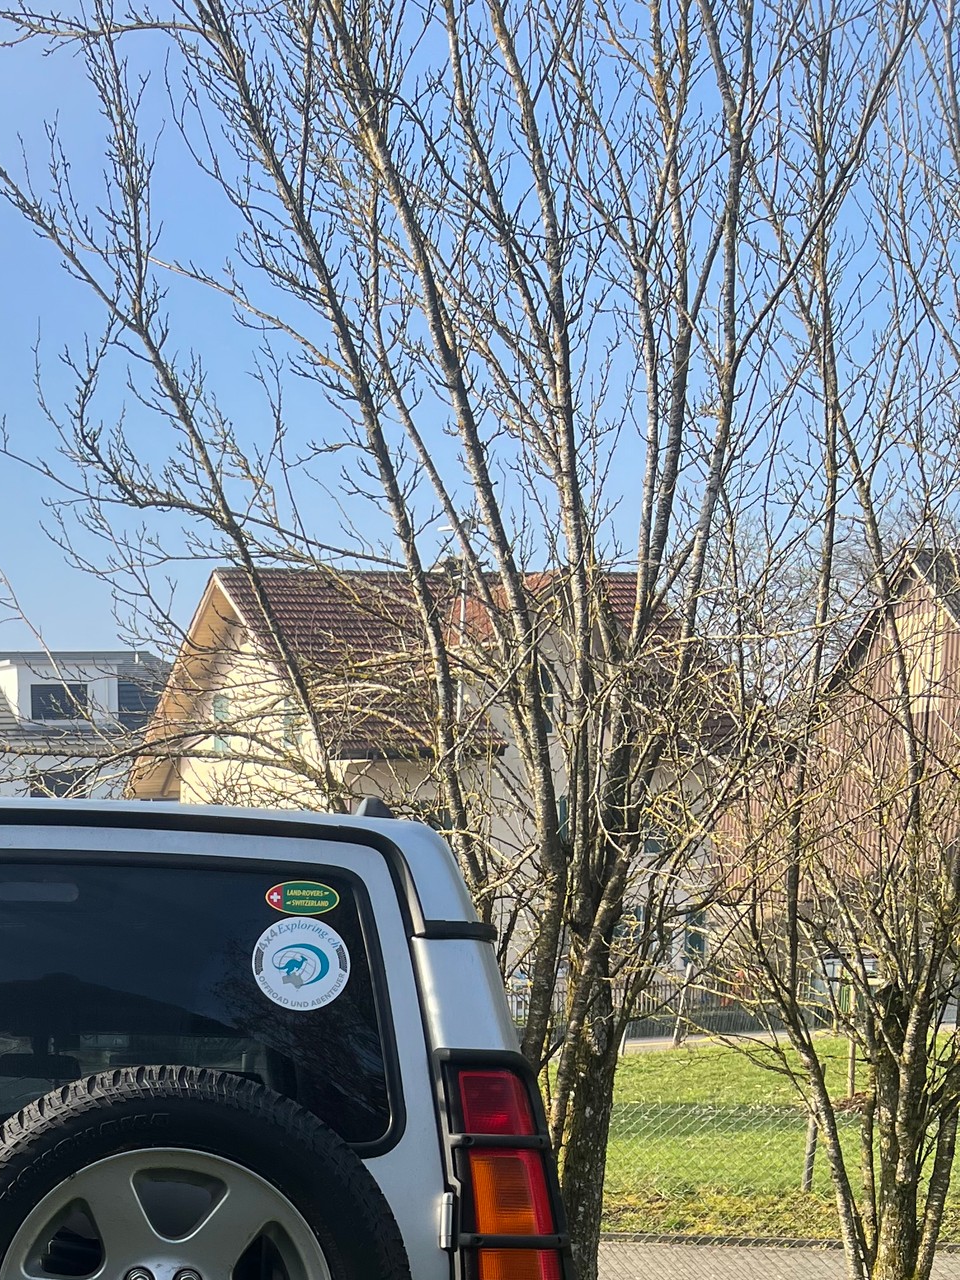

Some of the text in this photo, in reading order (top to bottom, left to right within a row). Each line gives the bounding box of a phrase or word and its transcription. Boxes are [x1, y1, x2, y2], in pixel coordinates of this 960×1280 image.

[291, 899, 329, 907] SWITZERLAND
[259, 972, 345, 1008] OFFROAD UND ABENTEUER
